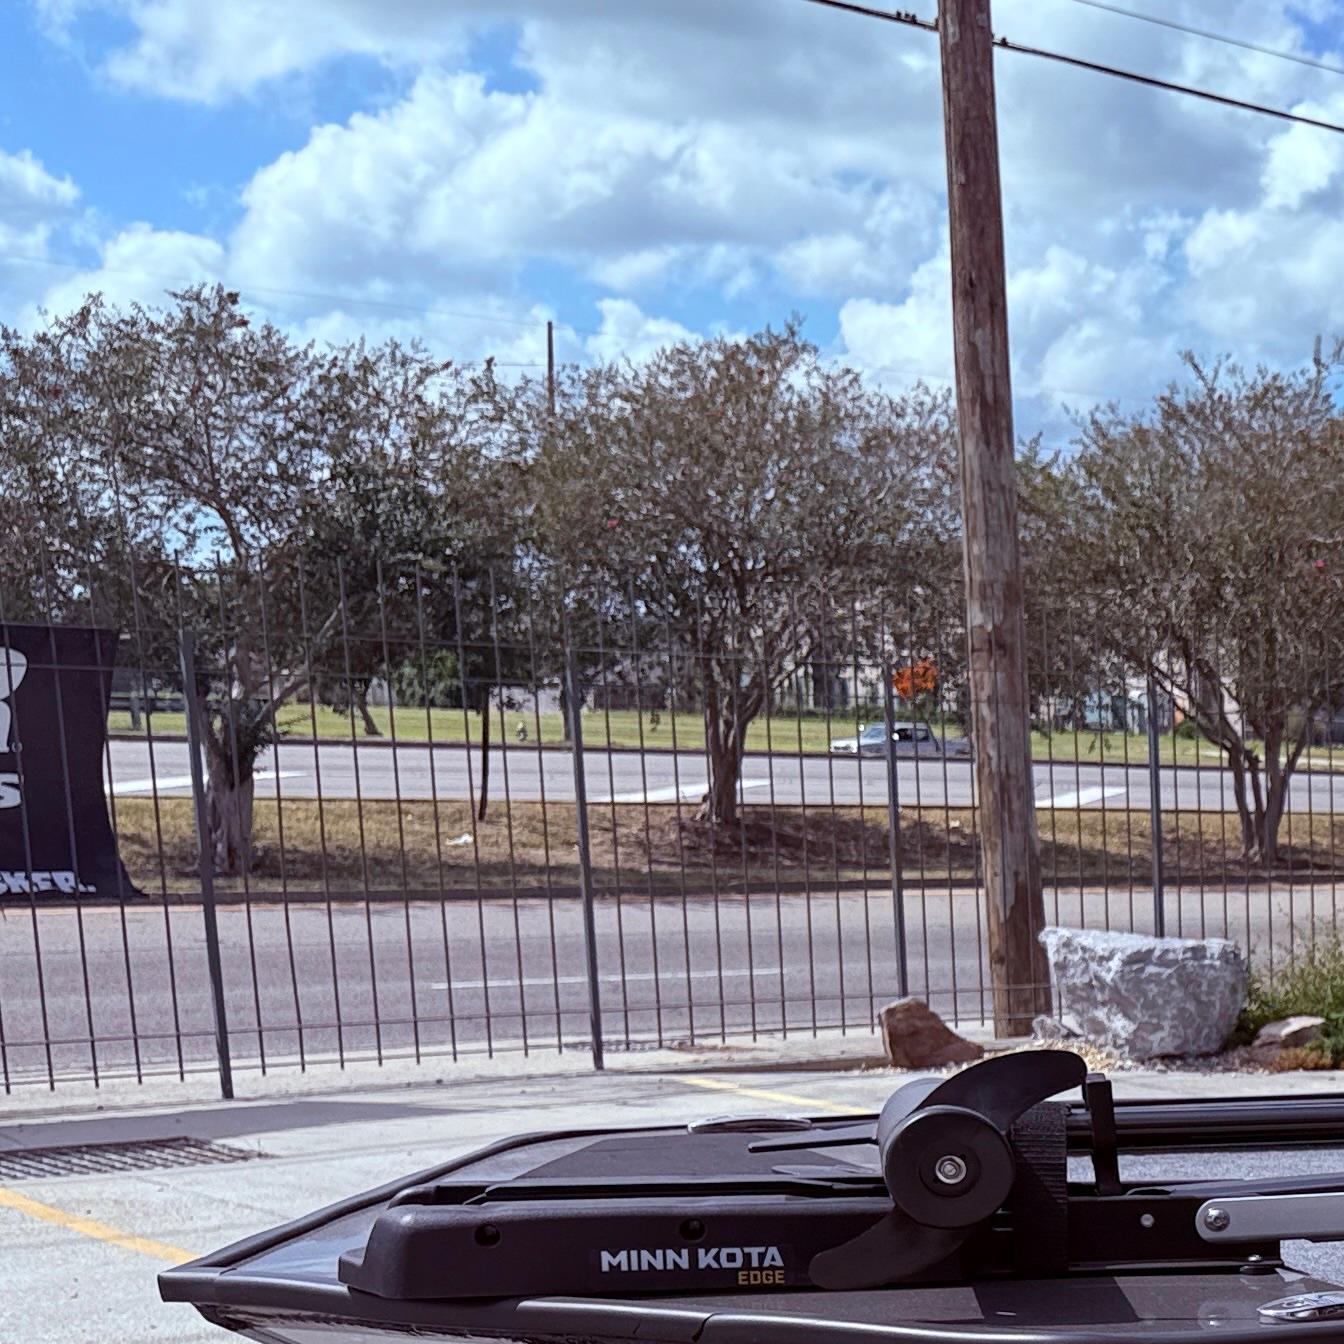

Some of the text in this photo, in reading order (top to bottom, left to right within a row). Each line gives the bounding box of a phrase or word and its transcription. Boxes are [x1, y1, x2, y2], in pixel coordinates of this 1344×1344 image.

[600, 1246, 785, 1273] MINN KOTA
[737, 1269, 785, 1286] EDGE
